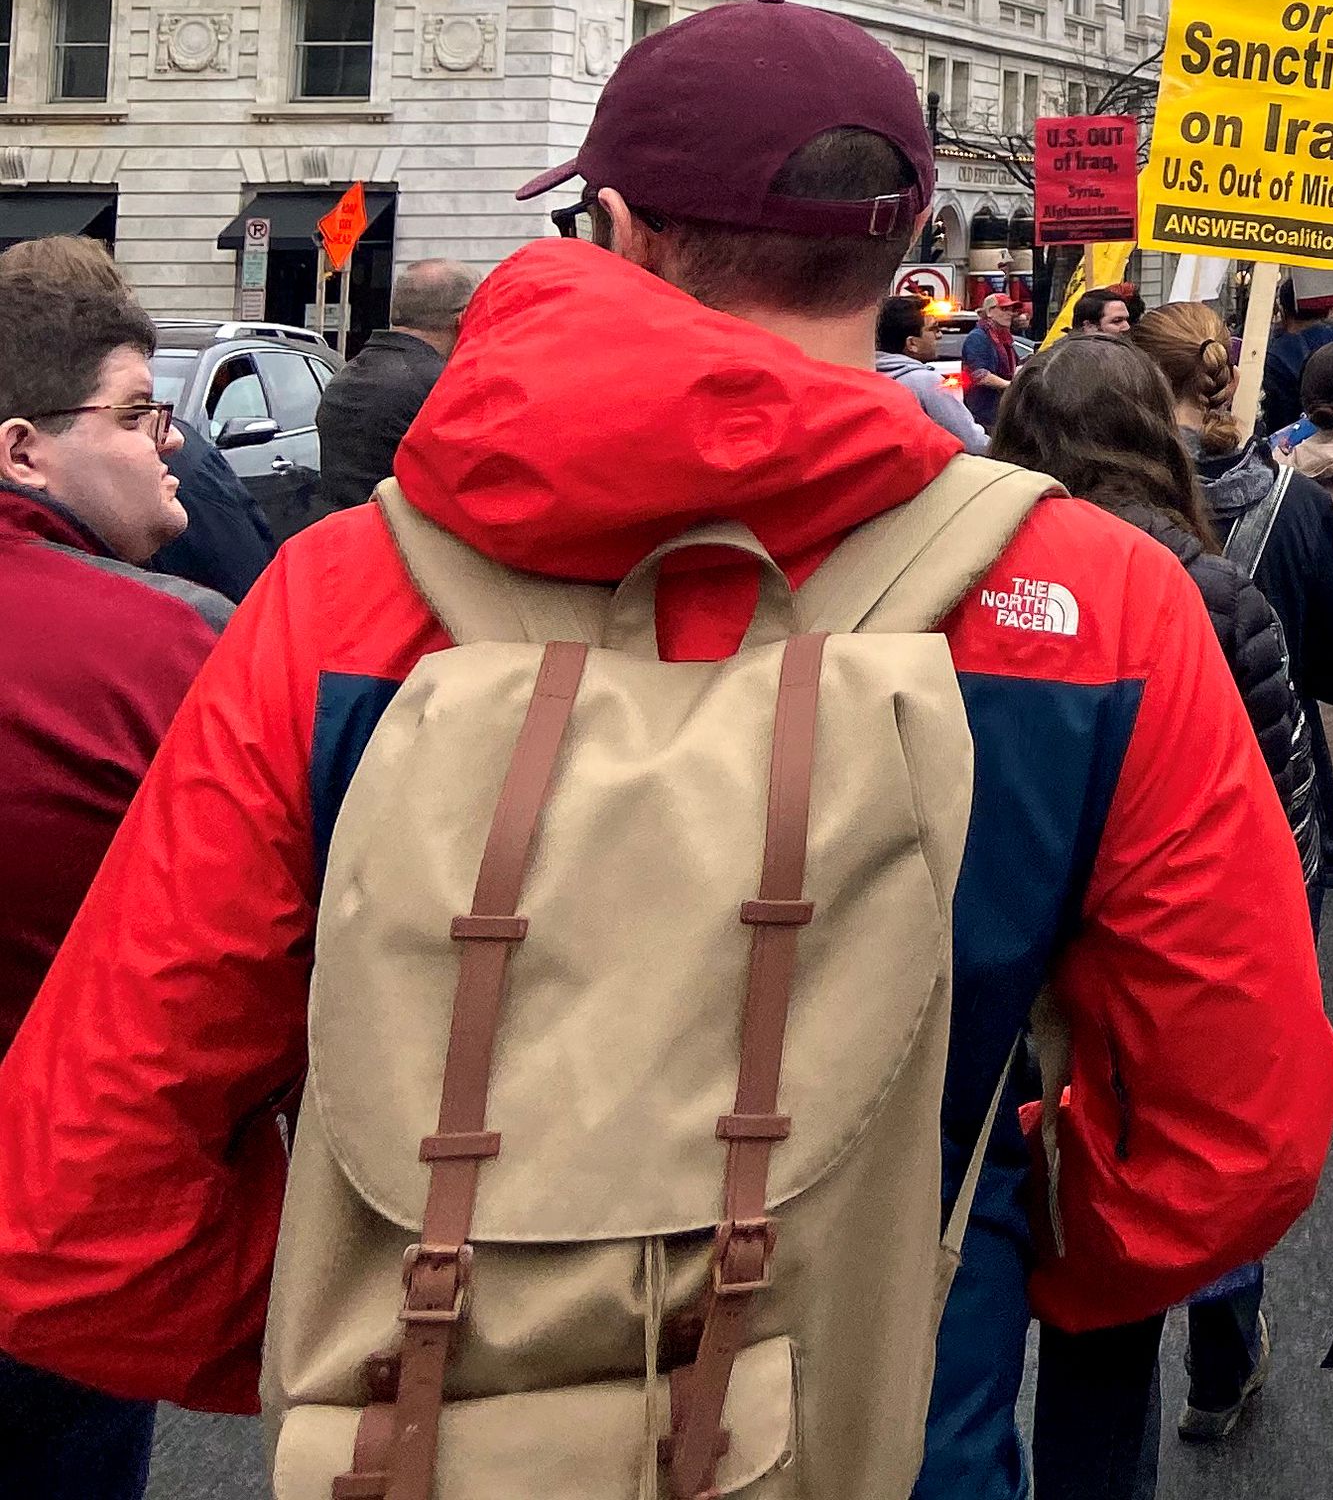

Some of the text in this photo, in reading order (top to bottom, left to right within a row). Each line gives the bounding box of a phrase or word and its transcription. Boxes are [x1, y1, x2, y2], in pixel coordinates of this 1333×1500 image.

[1282, 2, 1333, 33] or
[1046, 127, 1124, 148] U.S. OUT
[1181, 110, 1242, 148] on
[1054, 151, 1071, 171] of
[1163, 157, 1208, 193] U.S.
[1219, 164, 1262, 199] Out
[1269, 171, 1293, 202] of
[1012, 578, 1048, 597] THE
[981, 590, 1046, 614] NORTH
[996, 609, 1045, 631] FACE
